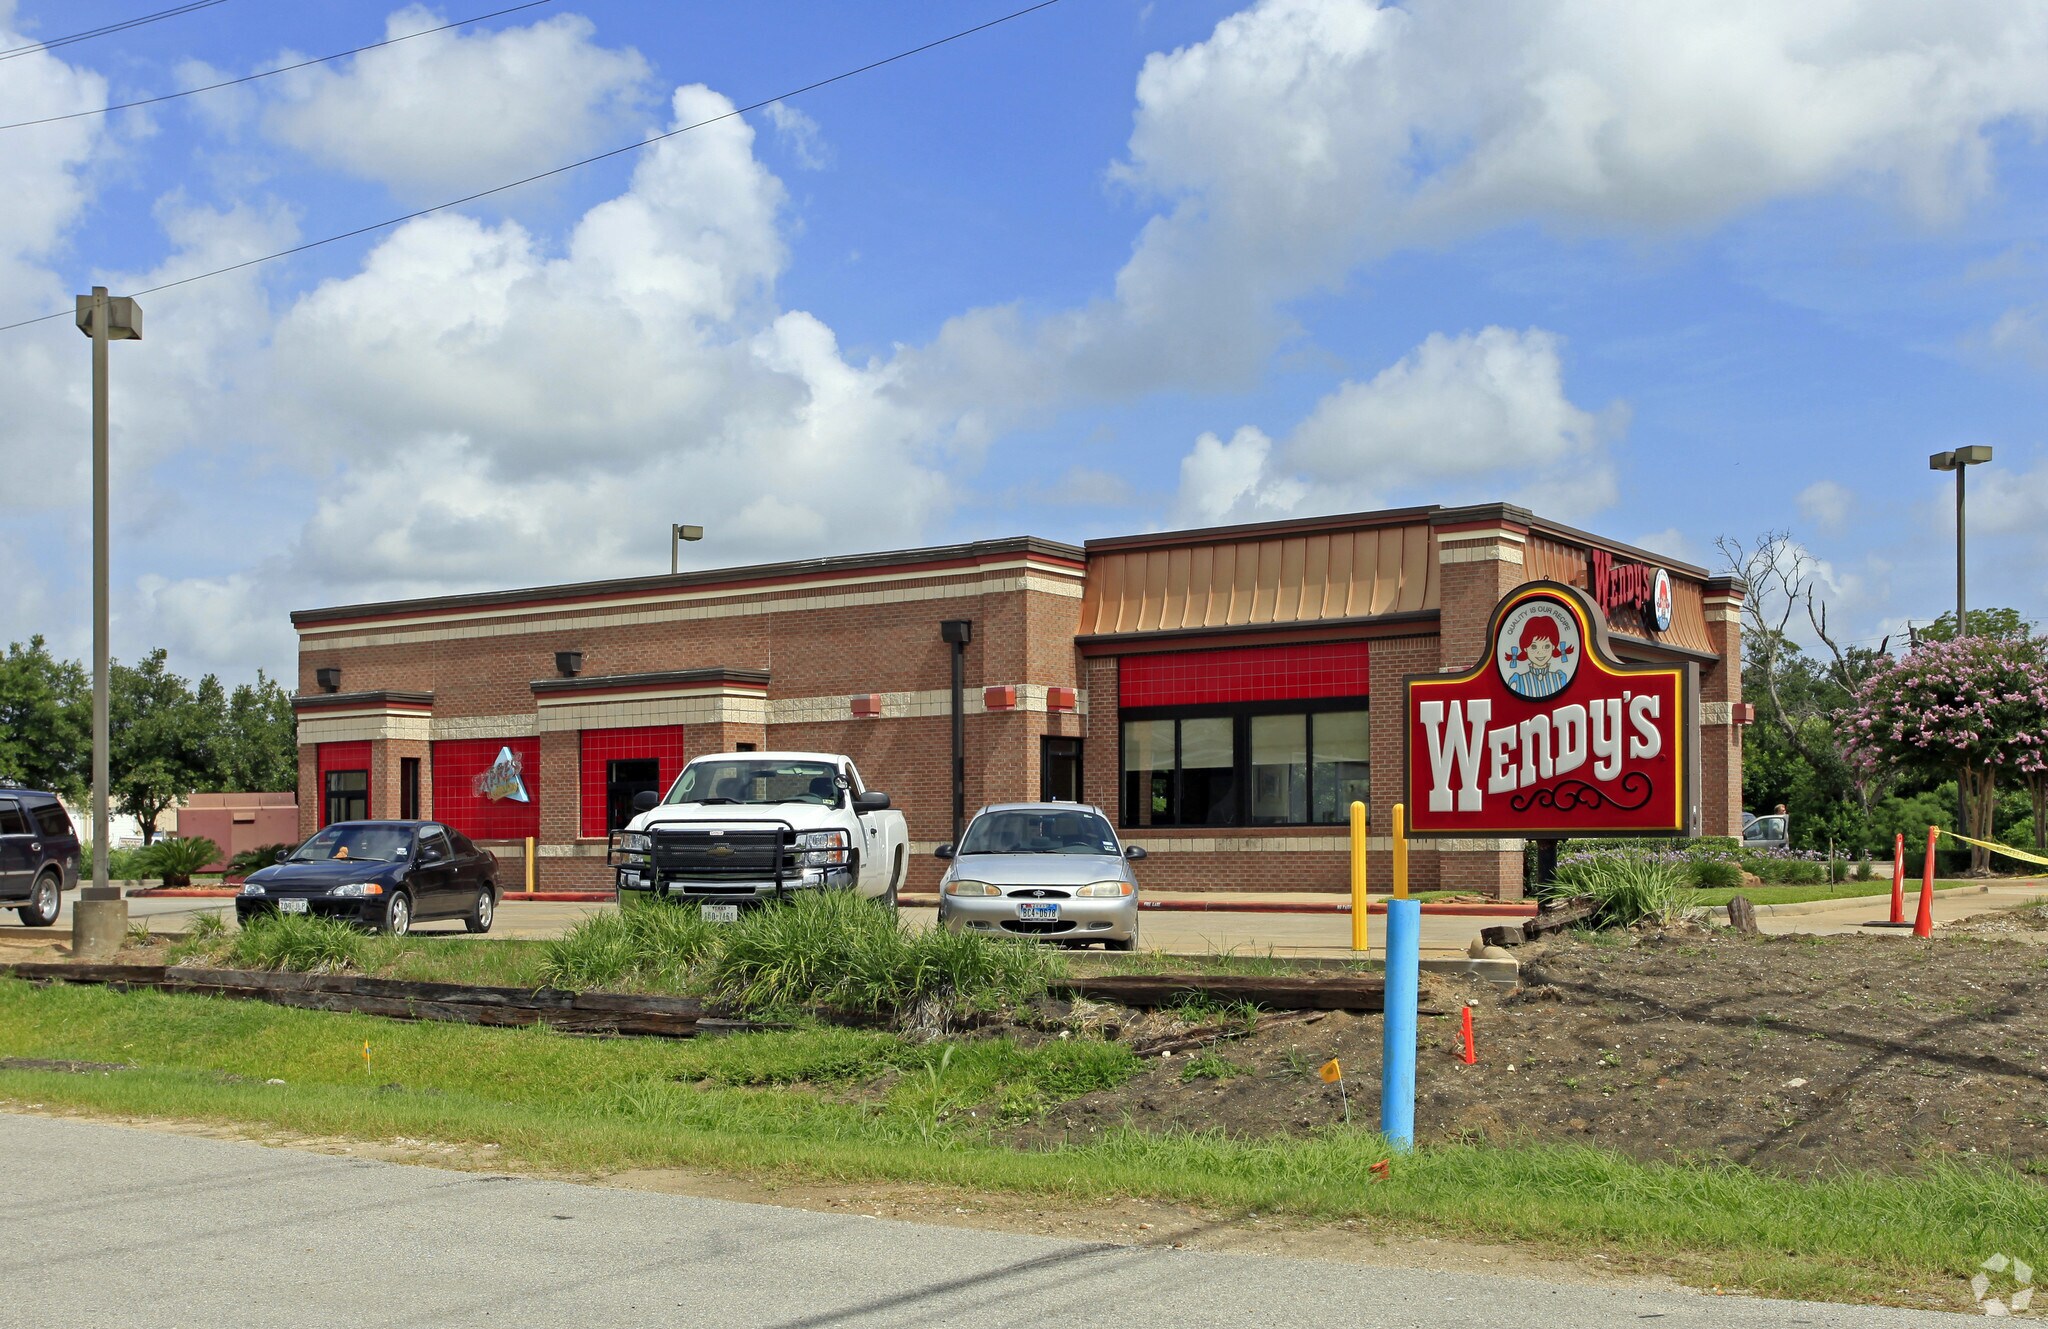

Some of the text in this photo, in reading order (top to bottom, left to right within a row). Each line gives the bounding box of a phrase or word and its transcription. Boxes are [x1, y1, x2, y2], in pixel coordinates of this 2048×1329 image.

[1507, 610, 1528, 635] QUALITY
[1537, 606, 1553, 614] OUR
[1552, 610, 1571, 631] RECIPE
